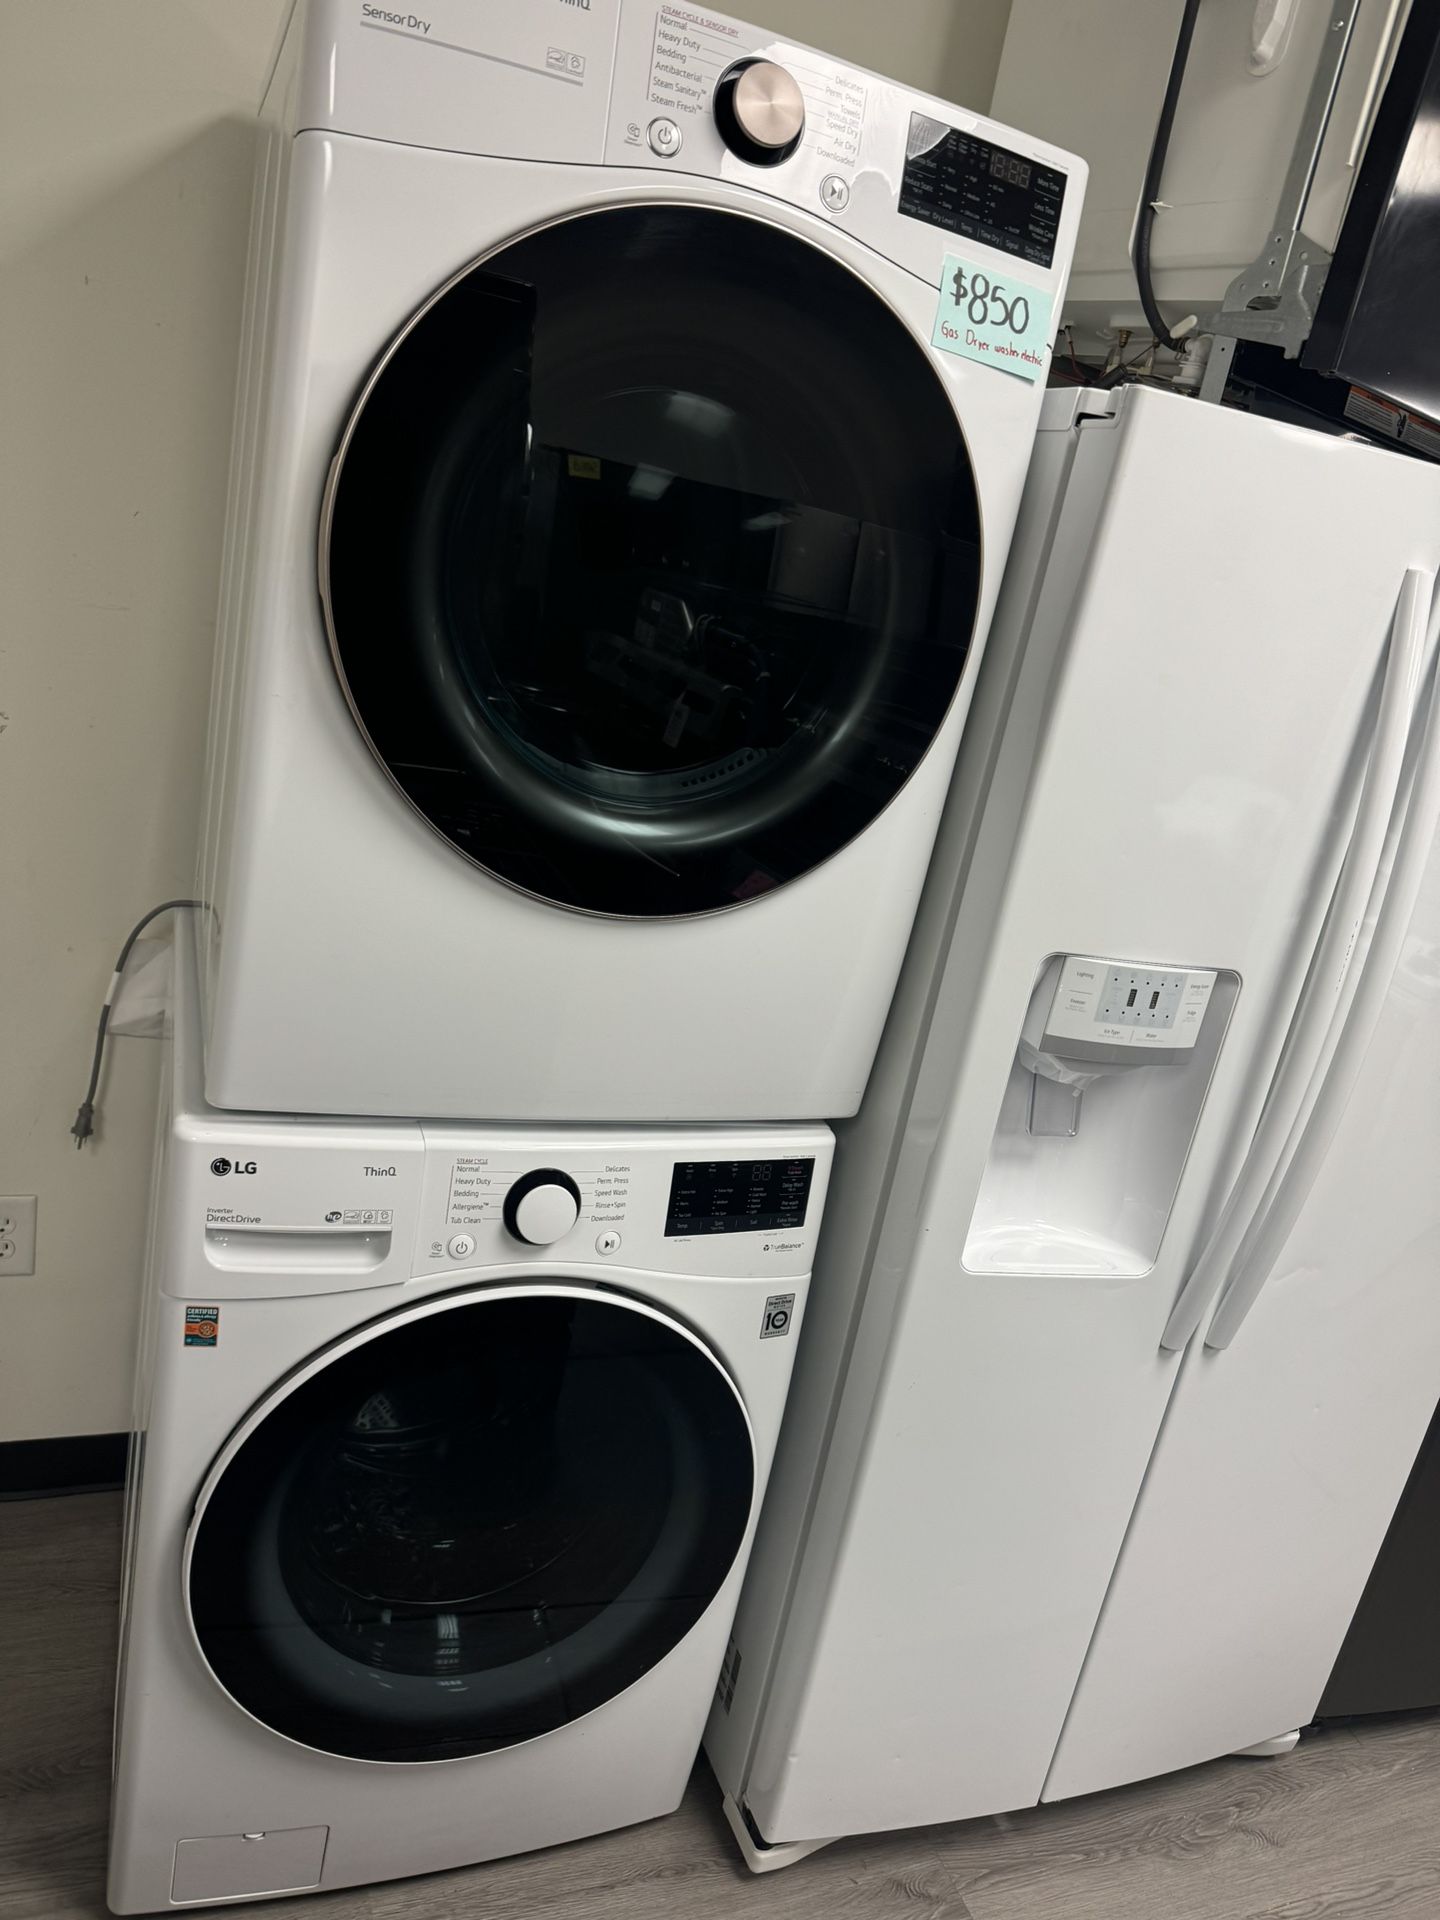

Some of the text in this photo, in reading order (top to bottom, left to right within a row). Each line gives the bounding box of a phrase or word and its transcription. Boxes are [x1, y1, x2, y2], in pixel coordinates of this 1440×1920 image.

[660, 14, 688, 30] Normal
[658, 30, 702, 52] Heavy Duty
[656, 45, 687, 64] Bedding
[654, 61, 703, 83] Antibacterial
[653, 76, 674, 90] Steam
[650, 93, 675, 108] Steam
[846, 126, 859, 139] Dry
[844, 140, 857, 154] Dry
[816, 146, 856, 168] Downloaded
[949, 266, 1030, 335] $850
[941, 320, 959, 340] Gas
[965, 329, 990, 351] Dryer
[234, 1161, 258, 1175] LG
[363, 1166, 398, 1177] ThinQ
[456, 1165, 481, 1173] Normal
[605, 1165, 631, 1173] Delicates
[455, 1177, 491, 1186] Heavy Duty
[614, 1176, 629, 1184] Press
[453, 1190, 480, 1198] Bedding
[594, 1189, 612, 1197] Speed
[450, 1216, 481, 1224] Tub Clean
[590, 1214, 625, 1222] Downloaded
[765, 1310, 788, 1331] 10
